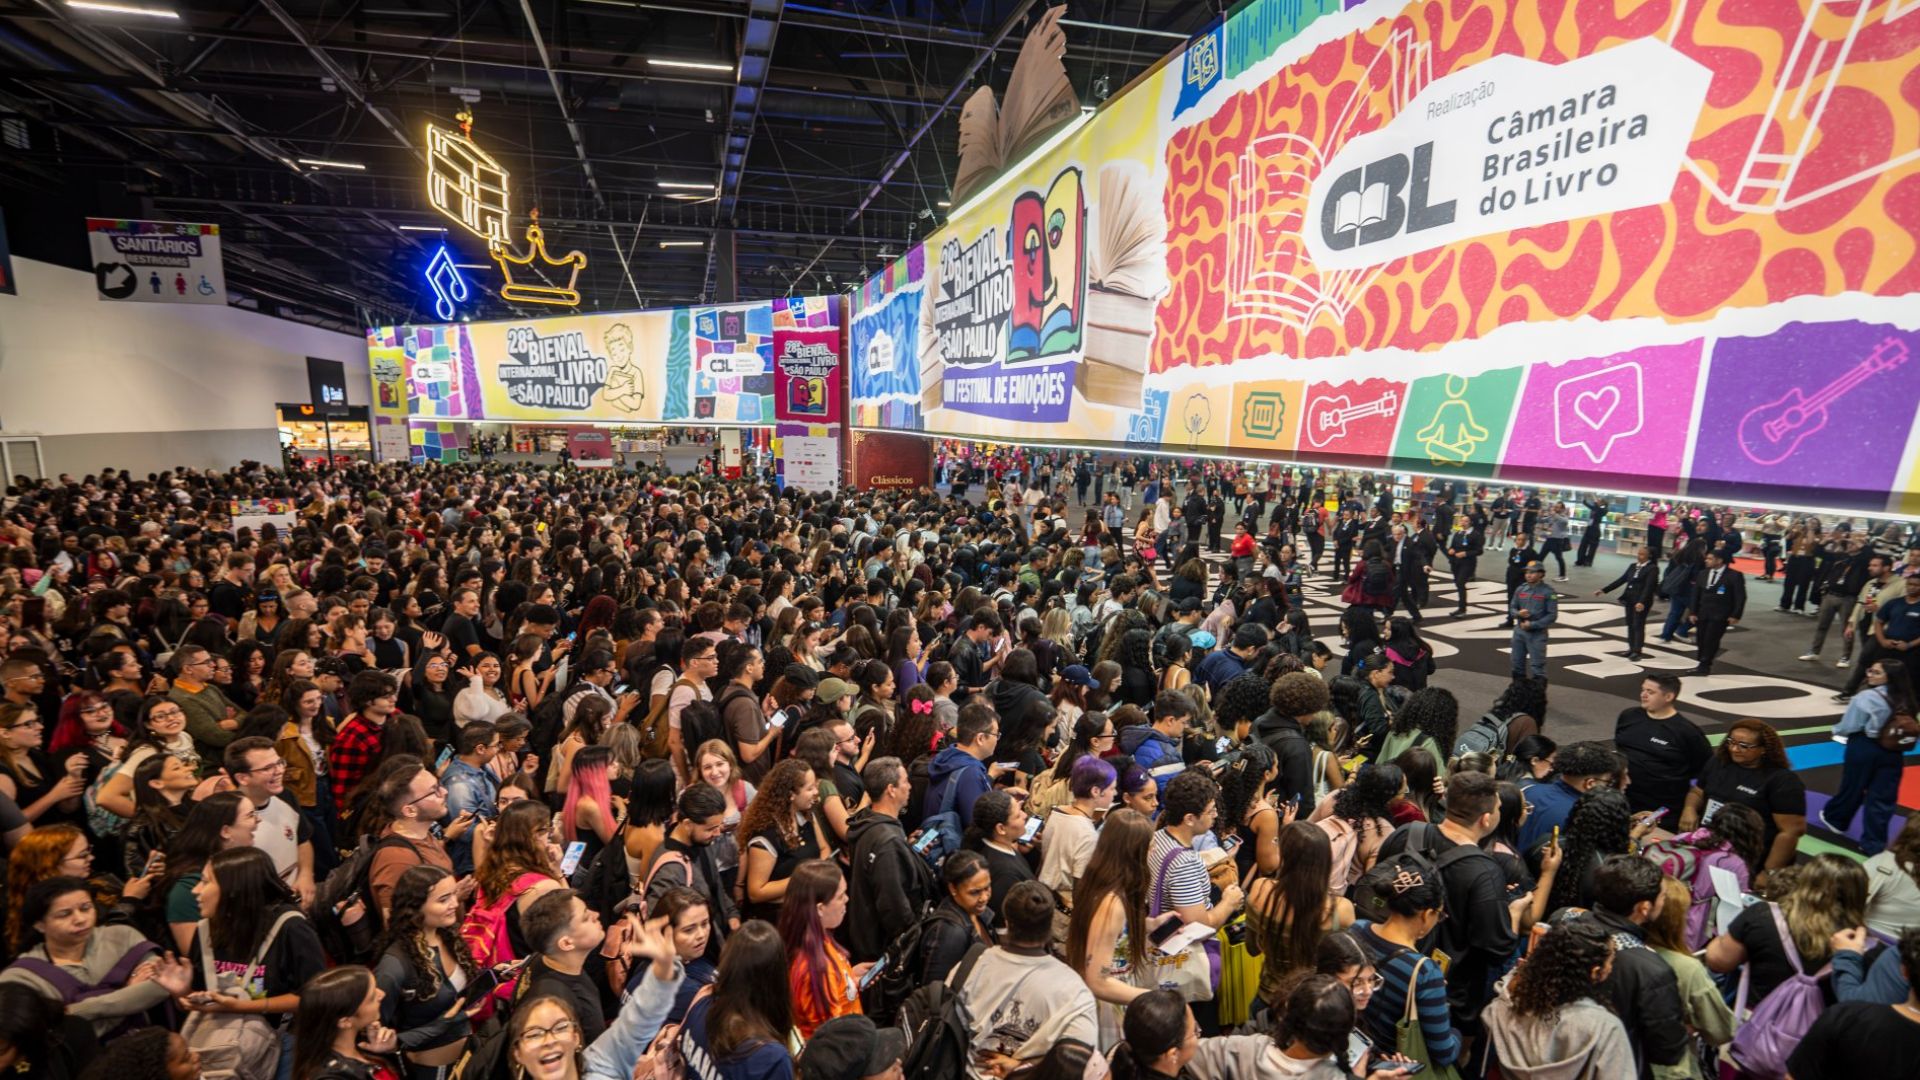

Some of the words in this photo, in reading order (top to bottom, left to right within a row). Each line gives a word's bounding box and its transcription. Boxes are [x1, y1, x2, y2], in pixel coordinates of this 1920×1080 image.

[1427, 79, 1496, 120] Realização
[1487, 84, 1617, 146] Câmara
[1482, 113, 1649, 182] Brasileira
[1320, 140, 1458, 252] CBL
[1479, 186, 1517, 217] do
[1524, 162, 1619, 207] Livro
[117, 236, 198, 255] SANITÁRIOS
[954, 229, 1000, 299] BIENAL
[974, 266, 1013, 325] LIVRO
[528, 332, 590, 366] BIENAL
[796, 344, 829, 359] BIENAL
[945, 322, 963, 360] SÃO
[963, 322, 996, 358] PAULO
[499, 365, 557, 378] INTERNACIONAL
[559, 357, 608, 386] LIVRO
[804, 366, 828, 376] PAULO
[812, 355, 839, 367] LIVRO
[517, 380, 543, 405] SÃO
[545, 384, 589, 407] PAULO
[943, 378, 956, 403] UM
[956, 376, 993, 404] FESTIVAL
[994, 376, 1008, 404] DE
[1009, 366, 1066, 413] EMOÇÕES
[870, 474, 914, 485] Clássicos
